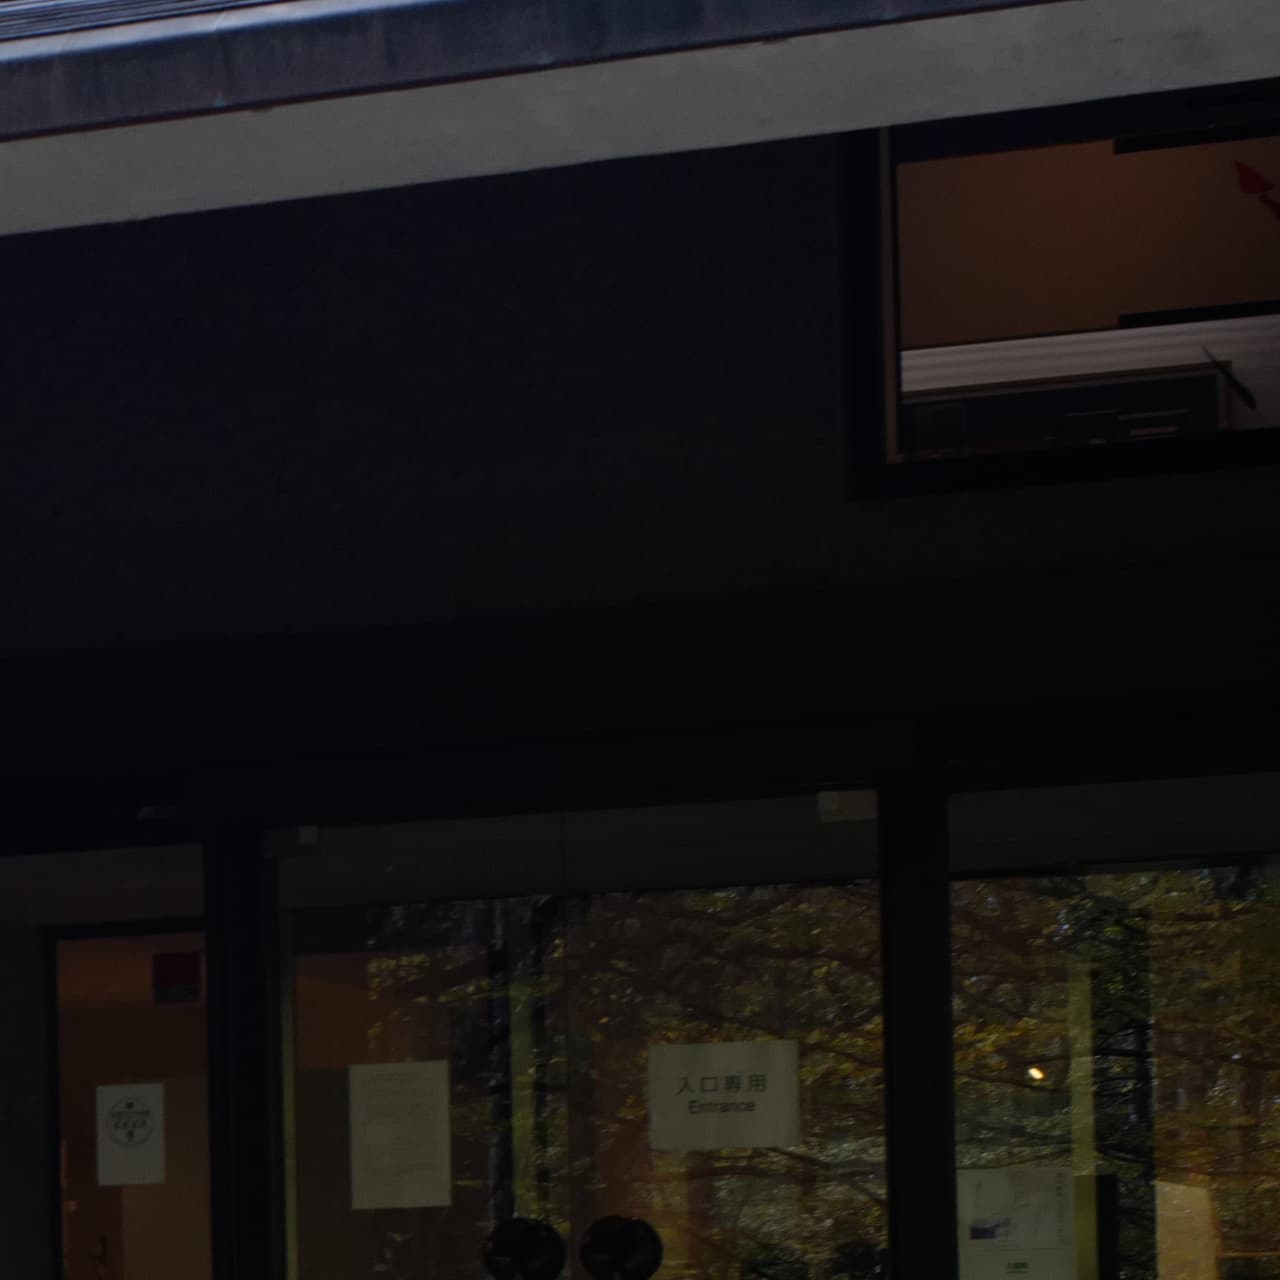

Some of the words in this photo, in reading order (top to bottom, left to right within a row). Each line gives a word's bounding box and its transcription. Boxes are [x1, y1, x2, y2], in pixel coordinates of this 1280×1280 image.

[676, 1074, 768, 1096] 入口専用
[688, 1099, 756, 1115] Entrance
